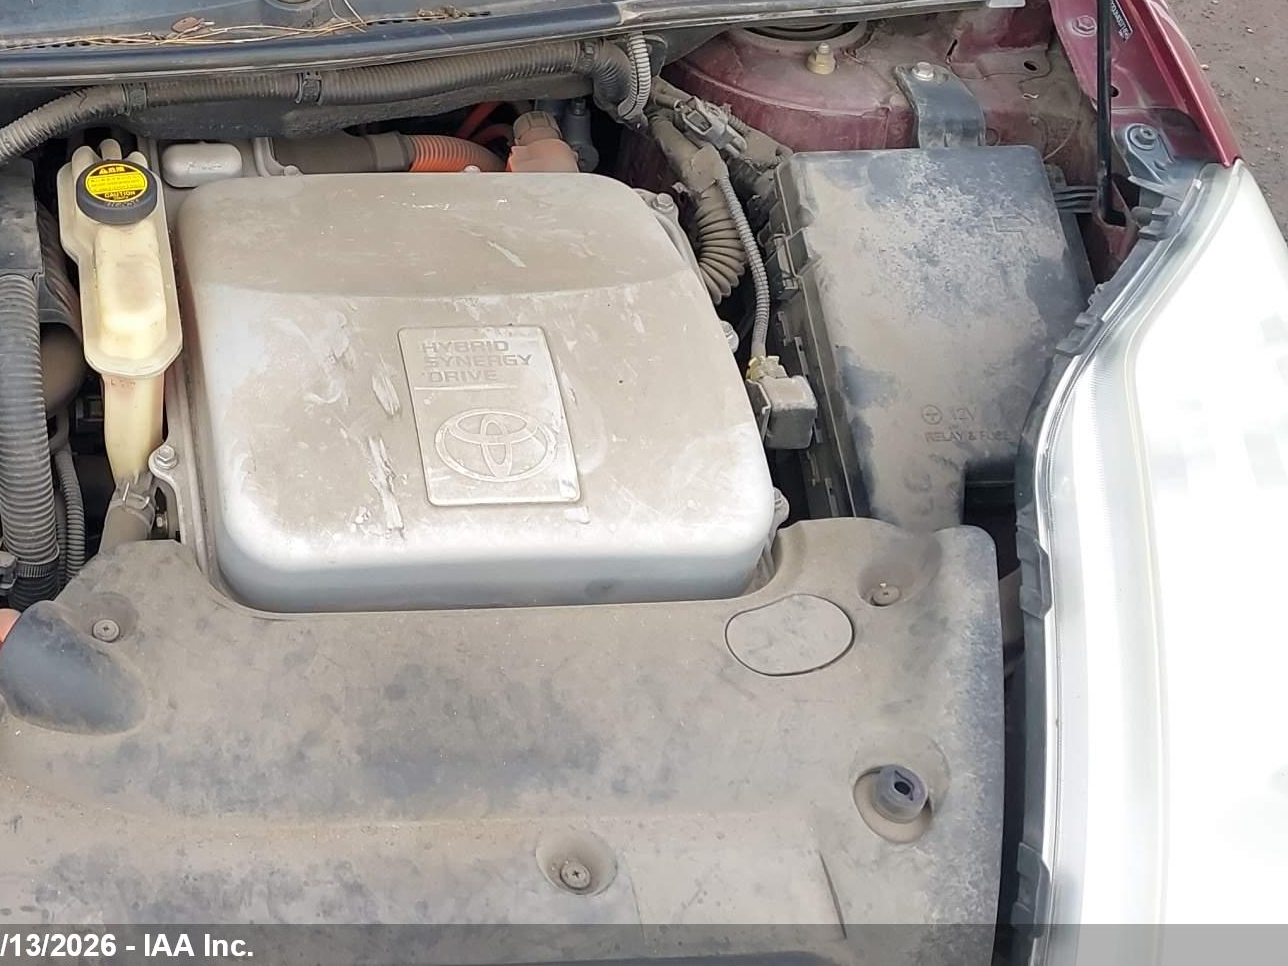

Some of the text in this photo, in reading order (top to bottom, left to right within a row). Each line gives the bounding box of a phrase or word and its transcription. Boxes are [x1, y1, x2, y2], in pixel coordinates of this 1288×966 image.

[105, 190, 136, 198] CAUTION
[422, 340, 509, 354] HYBRID
[424, 354, 532, 368] SYNERGY
[430, 370, 497, 383] DRIVE
